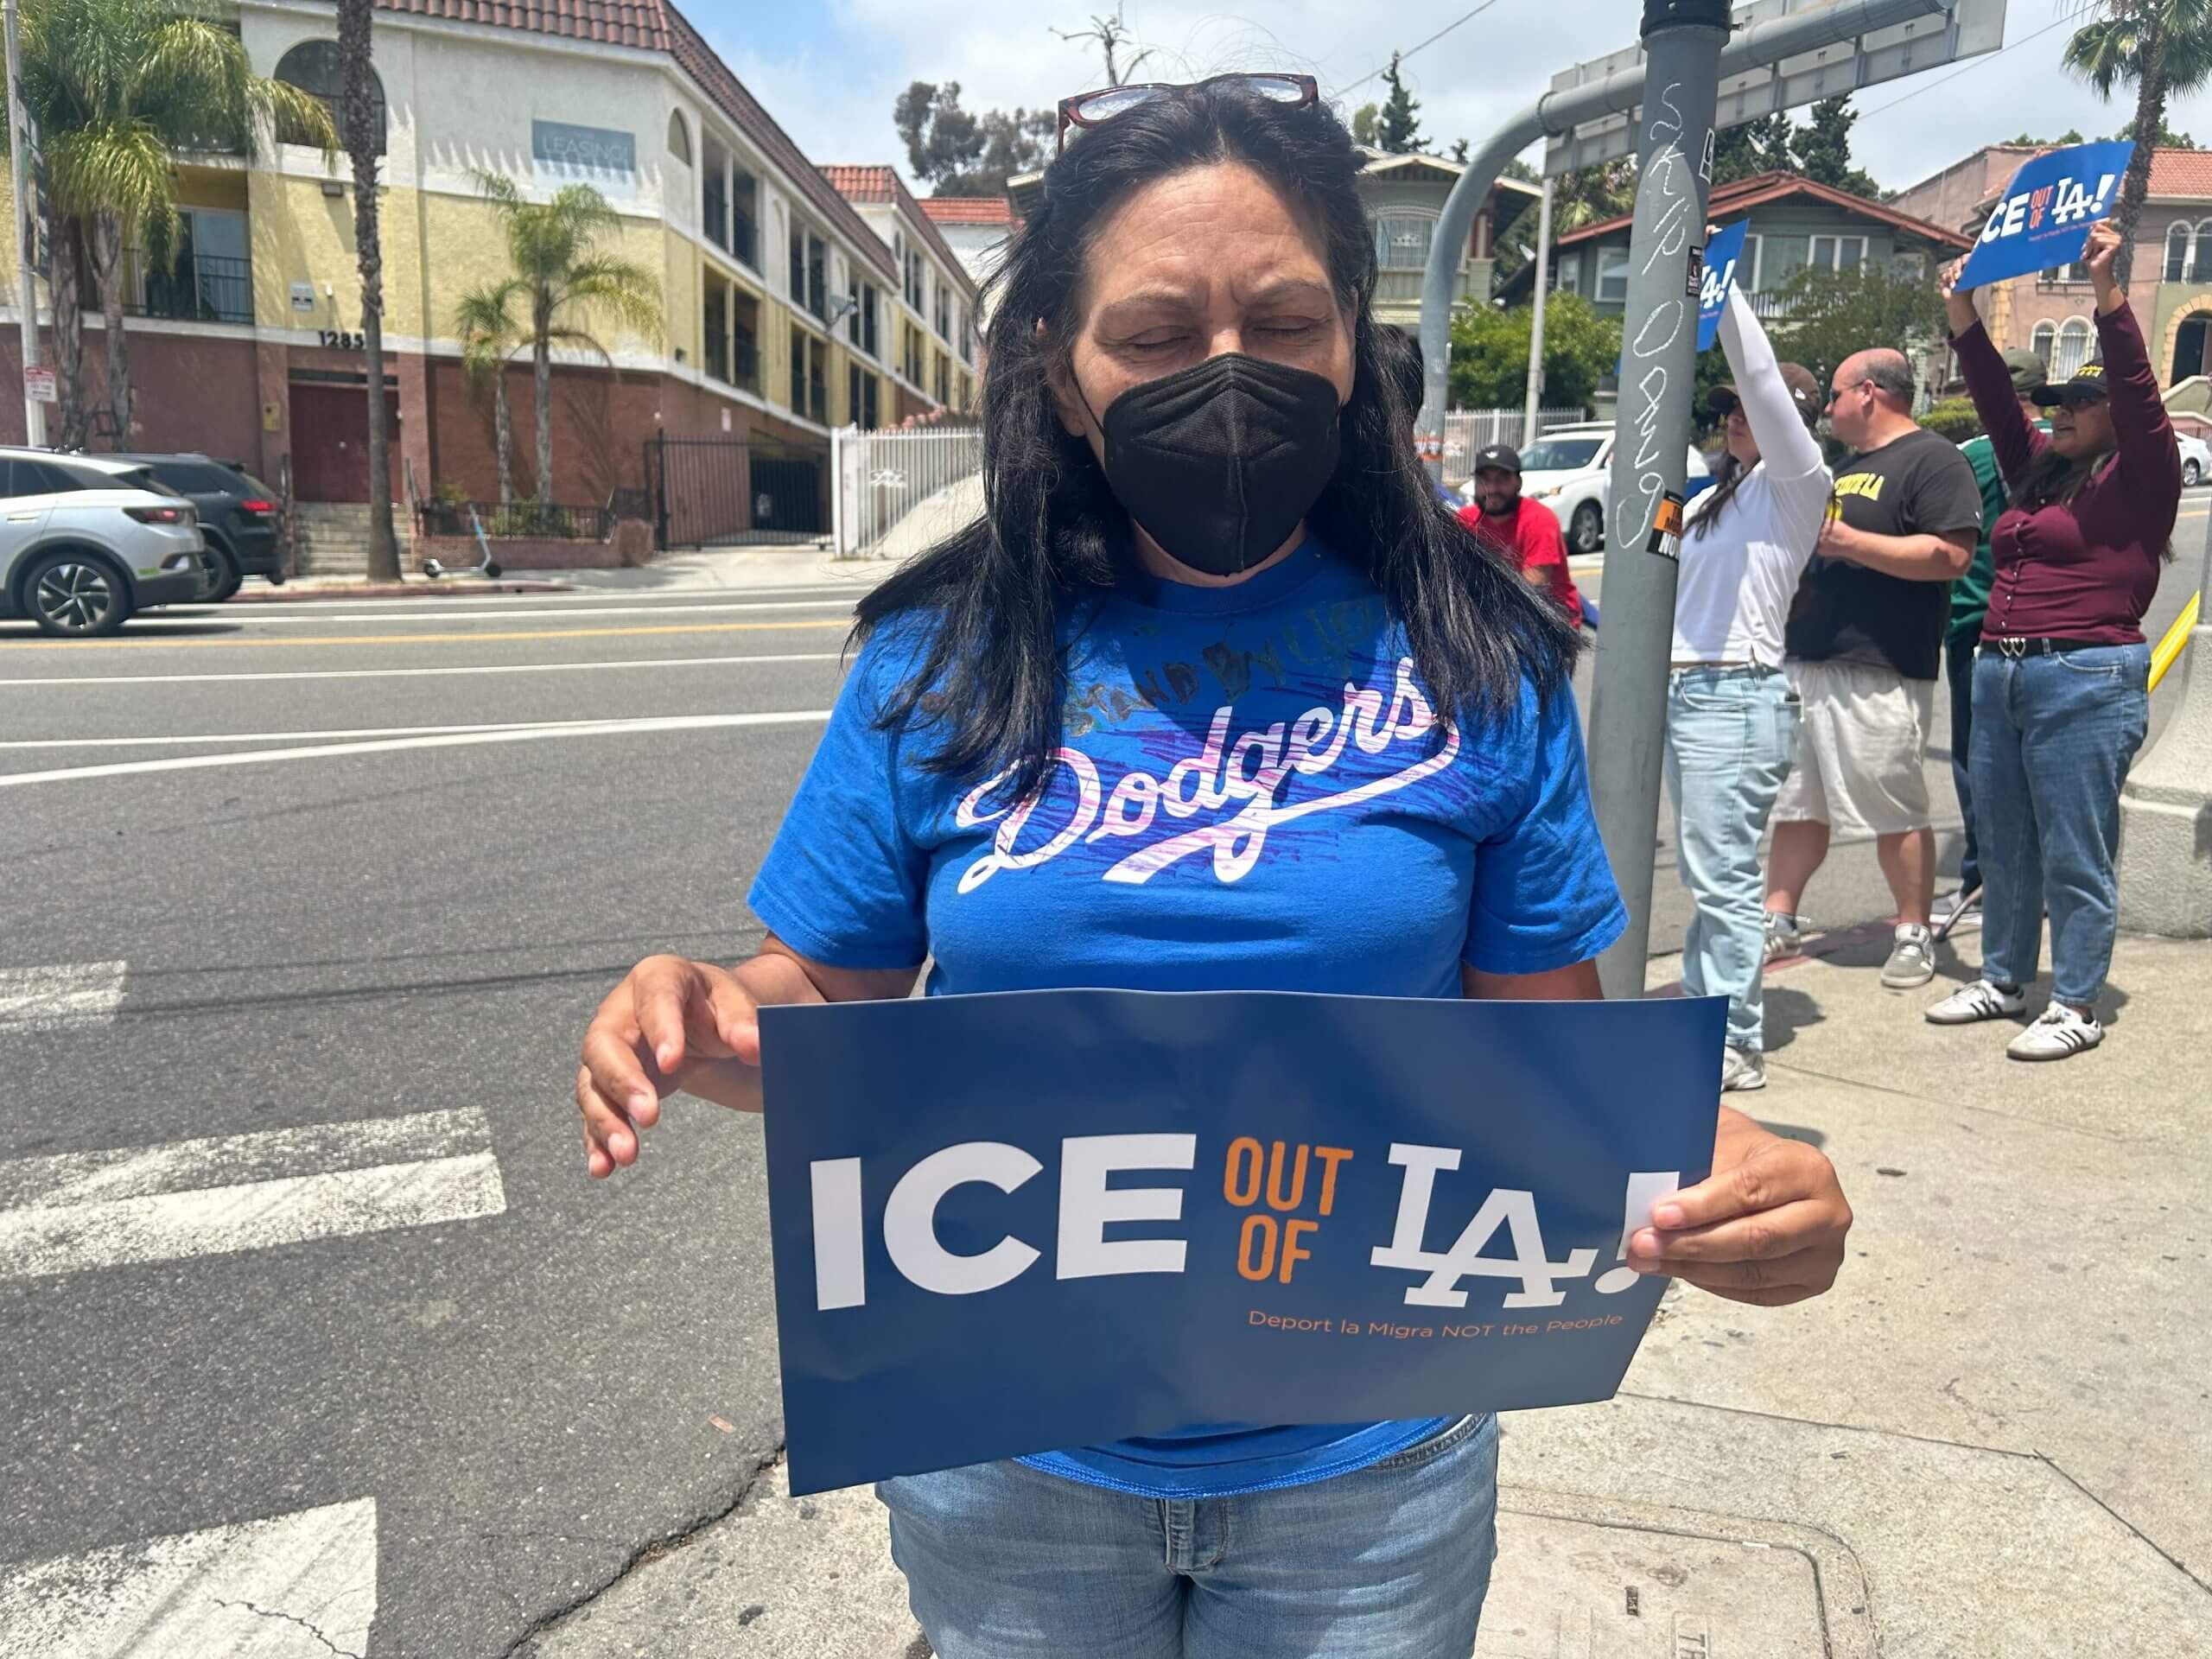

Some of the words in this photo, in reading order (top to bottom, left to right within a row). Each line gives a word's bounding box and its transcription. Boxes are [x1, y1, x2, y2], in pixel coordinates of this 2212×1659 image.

[2029, 208, 2045, 229] OF
[2031, 186, 2054, 209] OUT
[318, 330, 365, 347] 1285
[957, 657, 1459, 893] Dodgers
[1224, 1136, 1354, 1215] OUT
[810, 1133, 1197, 1311] ICE
[1236, 1215, 1319, 1284] OF
[1249, 1311, 1332, 1332] Deport
[1340, 1320, 1360, 1334] la
[1368, 1323, 1433, 1339] Migra
[1441, 1325, 1496, 1338] NOT
[1502, 1325, 1538, 1336] the
[1547, 1314, 1623, 1332] People
